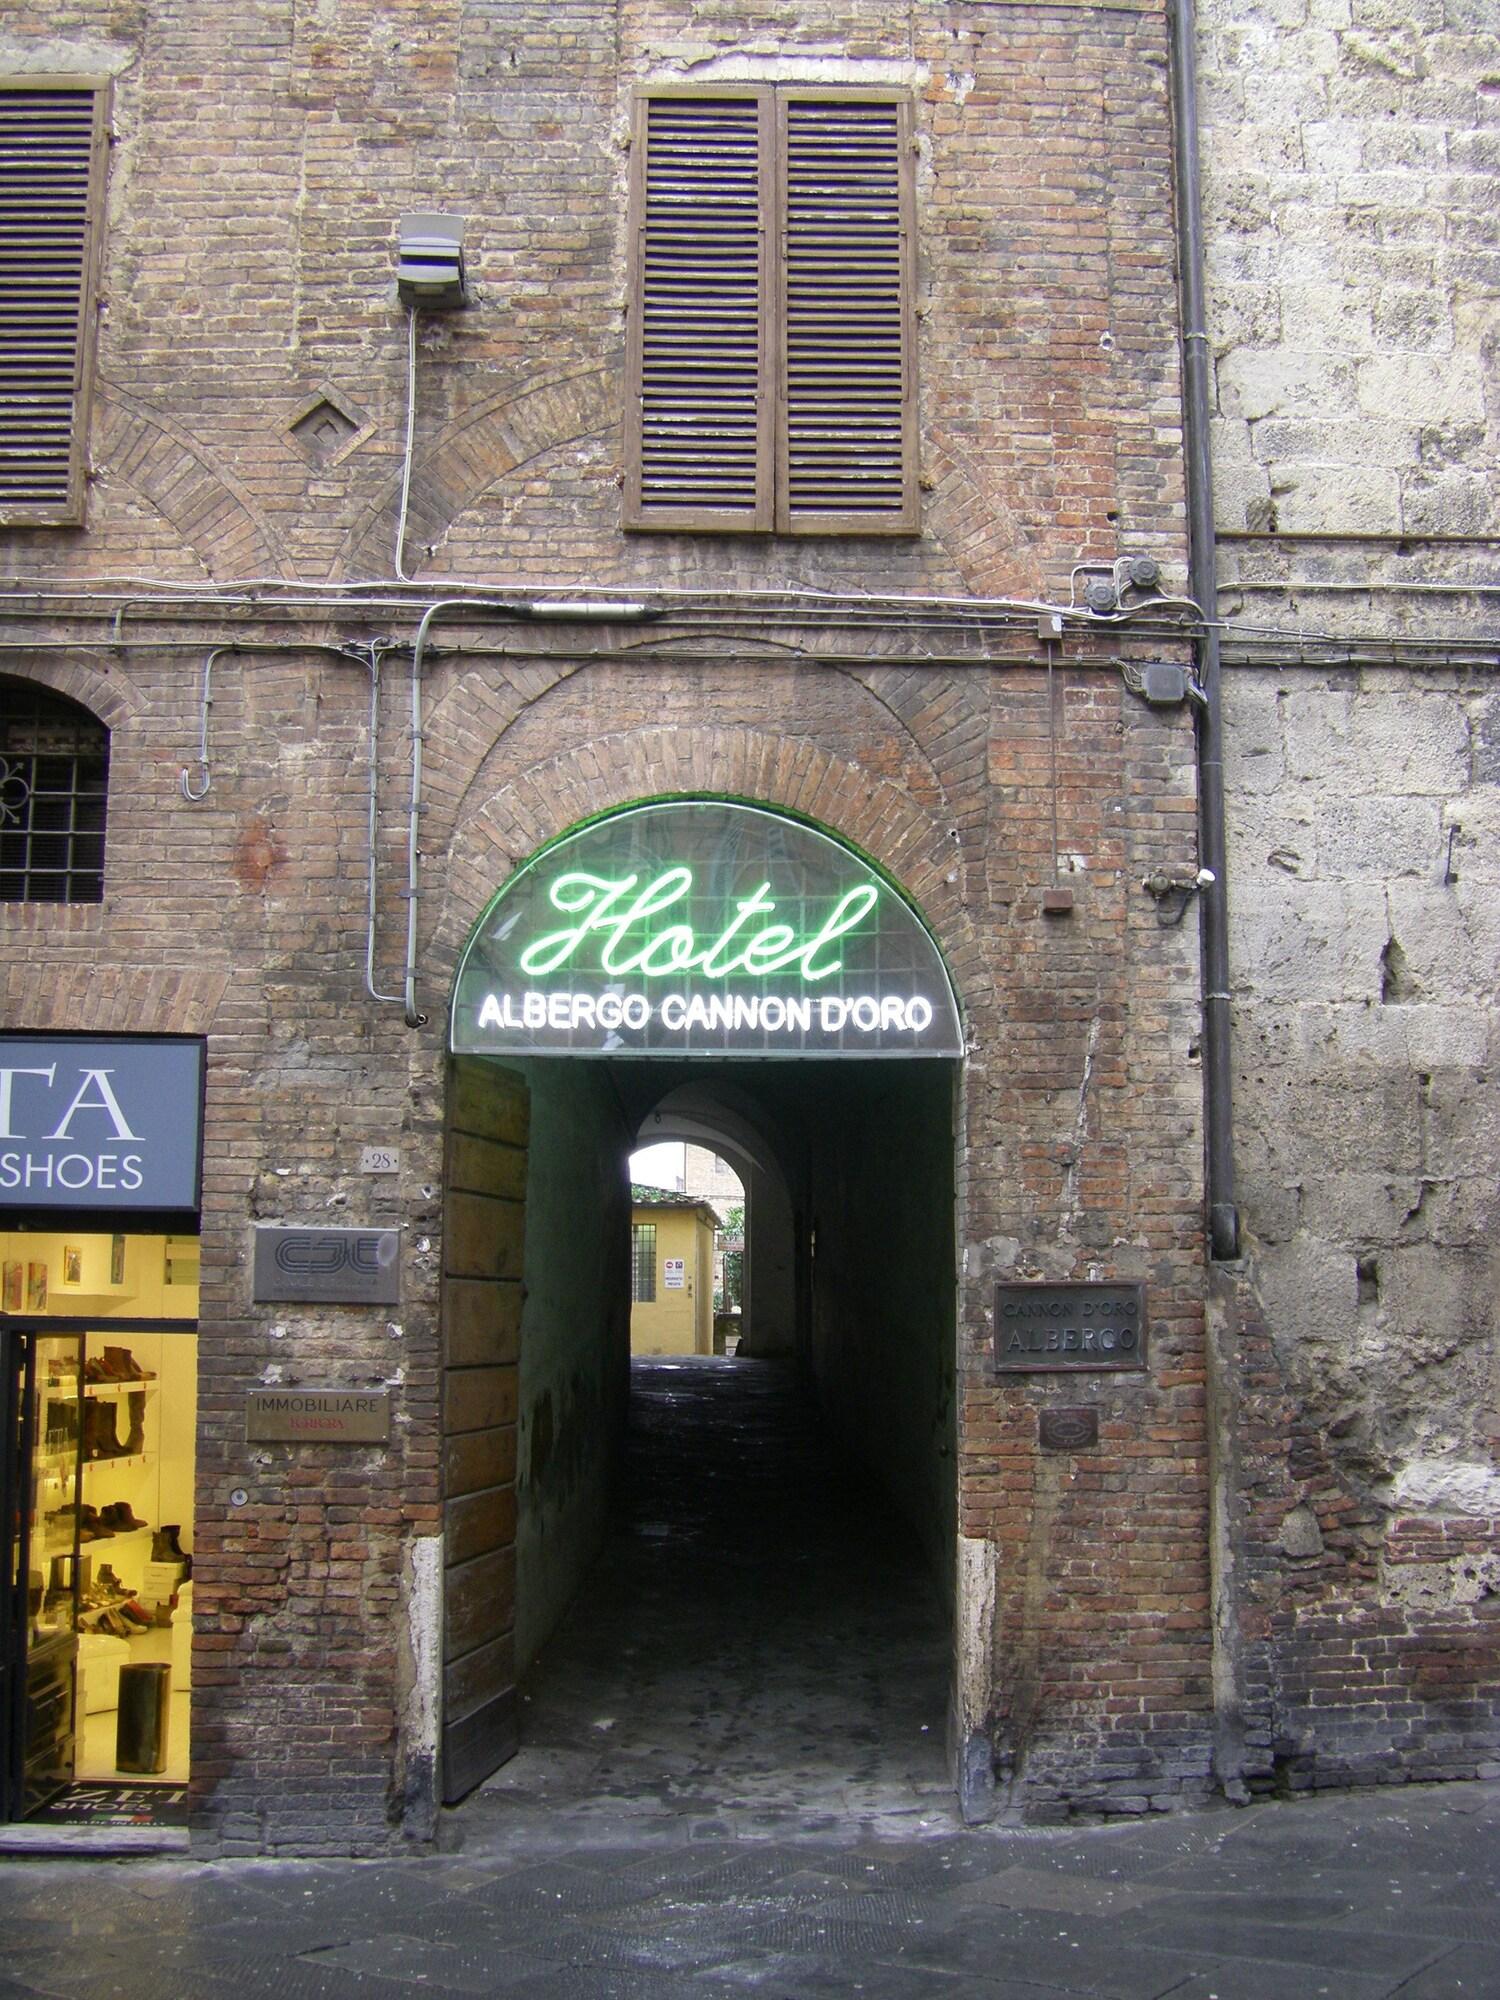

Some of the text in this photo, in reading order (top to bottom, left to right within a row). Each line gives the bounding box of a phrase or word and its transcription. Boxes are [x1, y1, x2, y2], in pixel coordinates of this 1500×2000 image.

[520, 866, 879, 982] Hotel
[478, 992, 933, 1033] ALBERGO CANNON D'ORO
[372, 1153, 390, 1168] 28
[0, 1153, 144, 1190] SHOES
[1003, 1301, 1137, 1318] CANNON D'ORO
[1007, 1328, 1136, 1352] ALBERGO
[256, 1398, 378, 1413] IMMOBILIARE
[50, 1801, 153, 1812] SHOES
